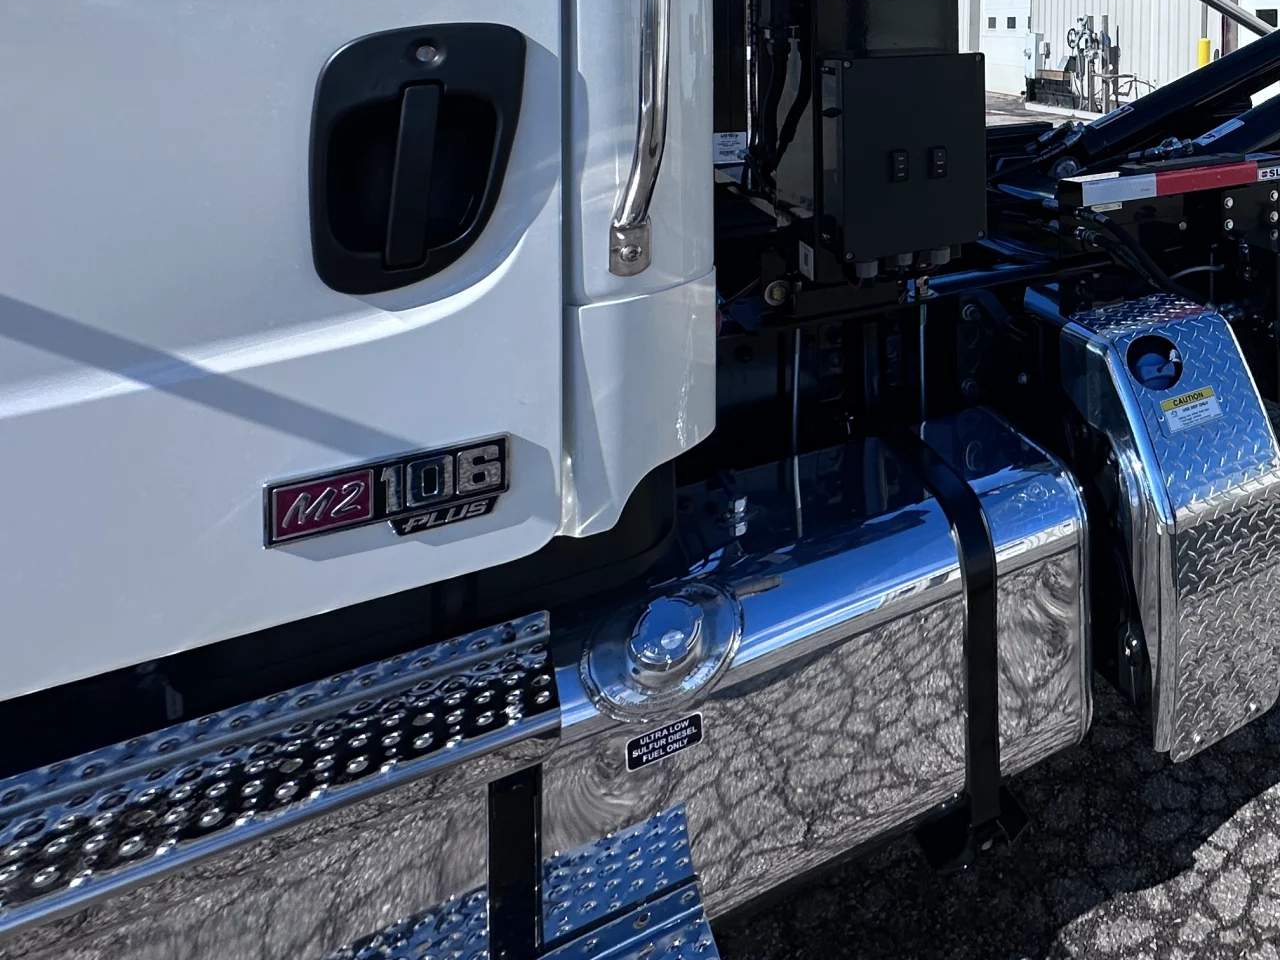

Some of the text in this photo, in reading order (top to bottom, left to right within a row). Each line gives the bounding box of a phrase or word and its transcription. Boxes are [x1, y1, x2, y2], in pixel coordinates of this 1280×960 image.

[1172, 391, 1204, 407] CAUTION
[281, 443, 502, 529] M2 106
[402, 499, 490, 534] PLUS
[632, 726, 698, 758] SULFUR DIESEL
[640, 719, 690, 745] ULTRA LOW
[642, 738, 689, 763] FUEL ONLY
